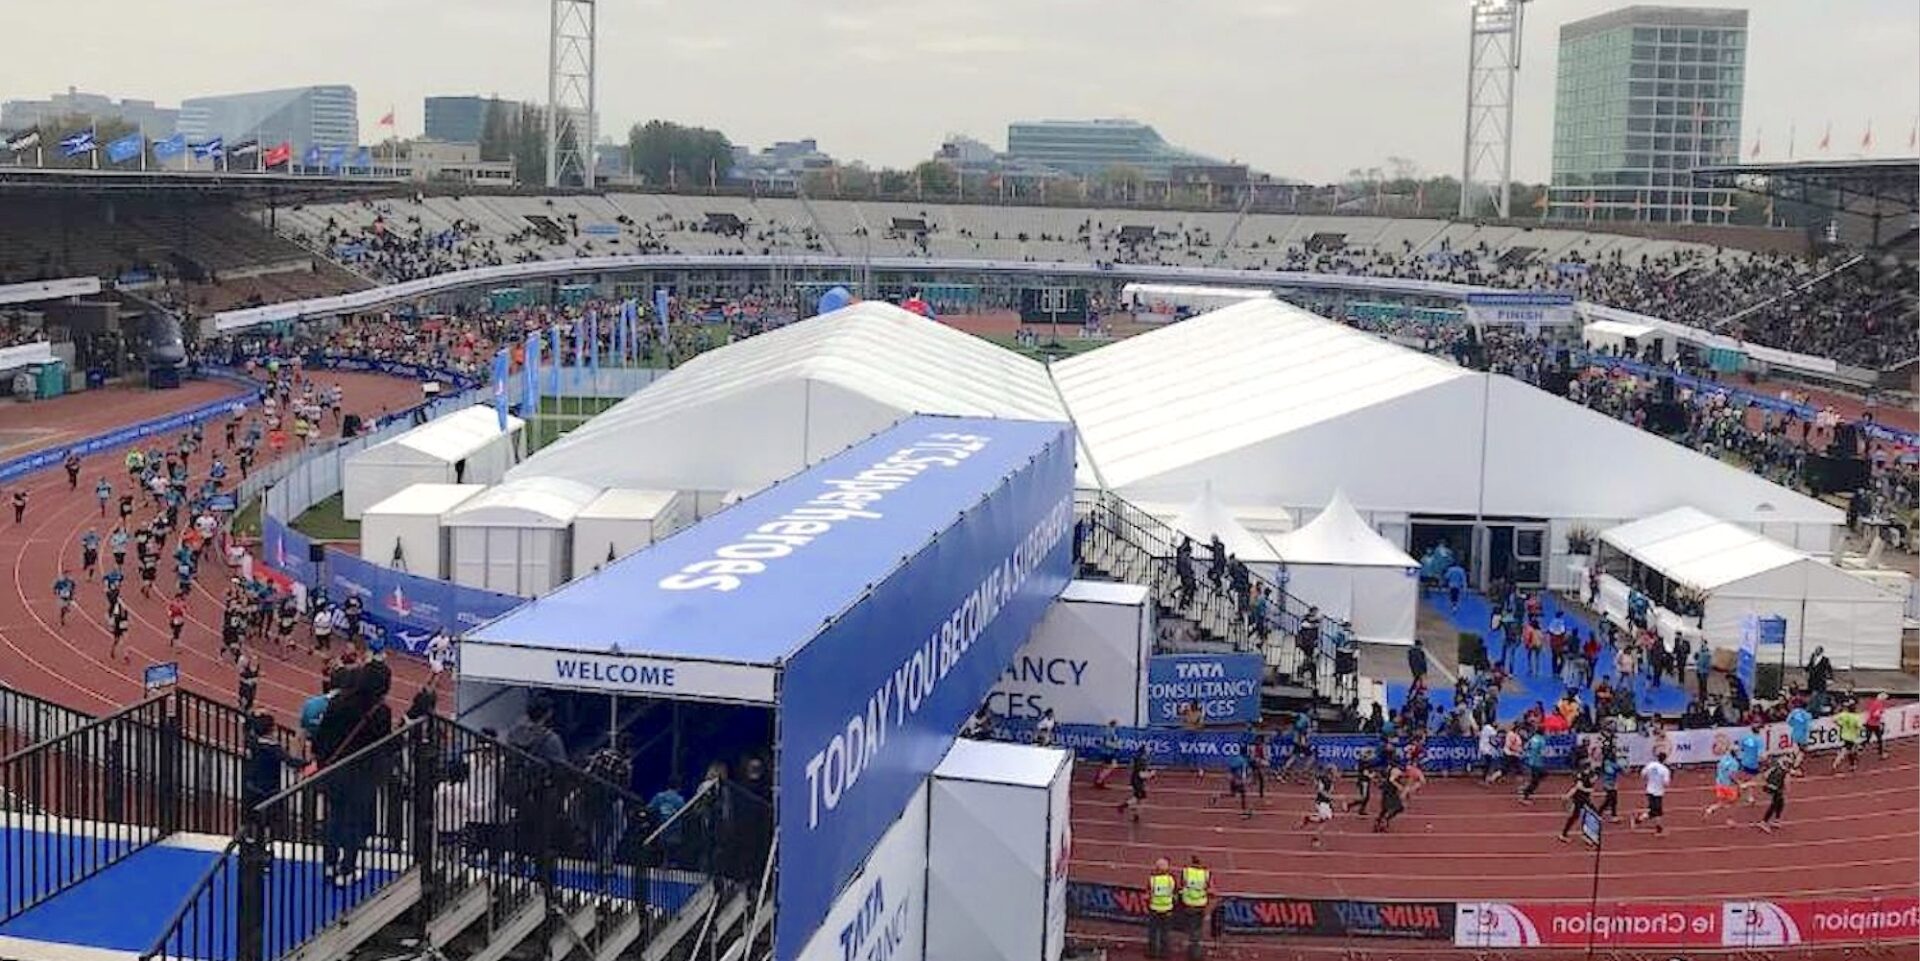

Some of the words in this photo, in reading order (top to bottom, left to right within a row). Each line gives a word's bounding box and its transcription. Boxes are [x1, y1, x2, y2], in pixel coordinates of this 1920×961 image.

[556, 659, 676, 687] WELCOME
[998, 656, 1088, 686] ANCY
[1175, 662, 1225, 679] TATA
[805, 677, 893, 831] TODAY
[895, 633, 938, 727] YOU
[939, 565, 1000, 680] BECOME
[985, 692, 1044, 720] CES
[839, 876, 884, 961] TATA
